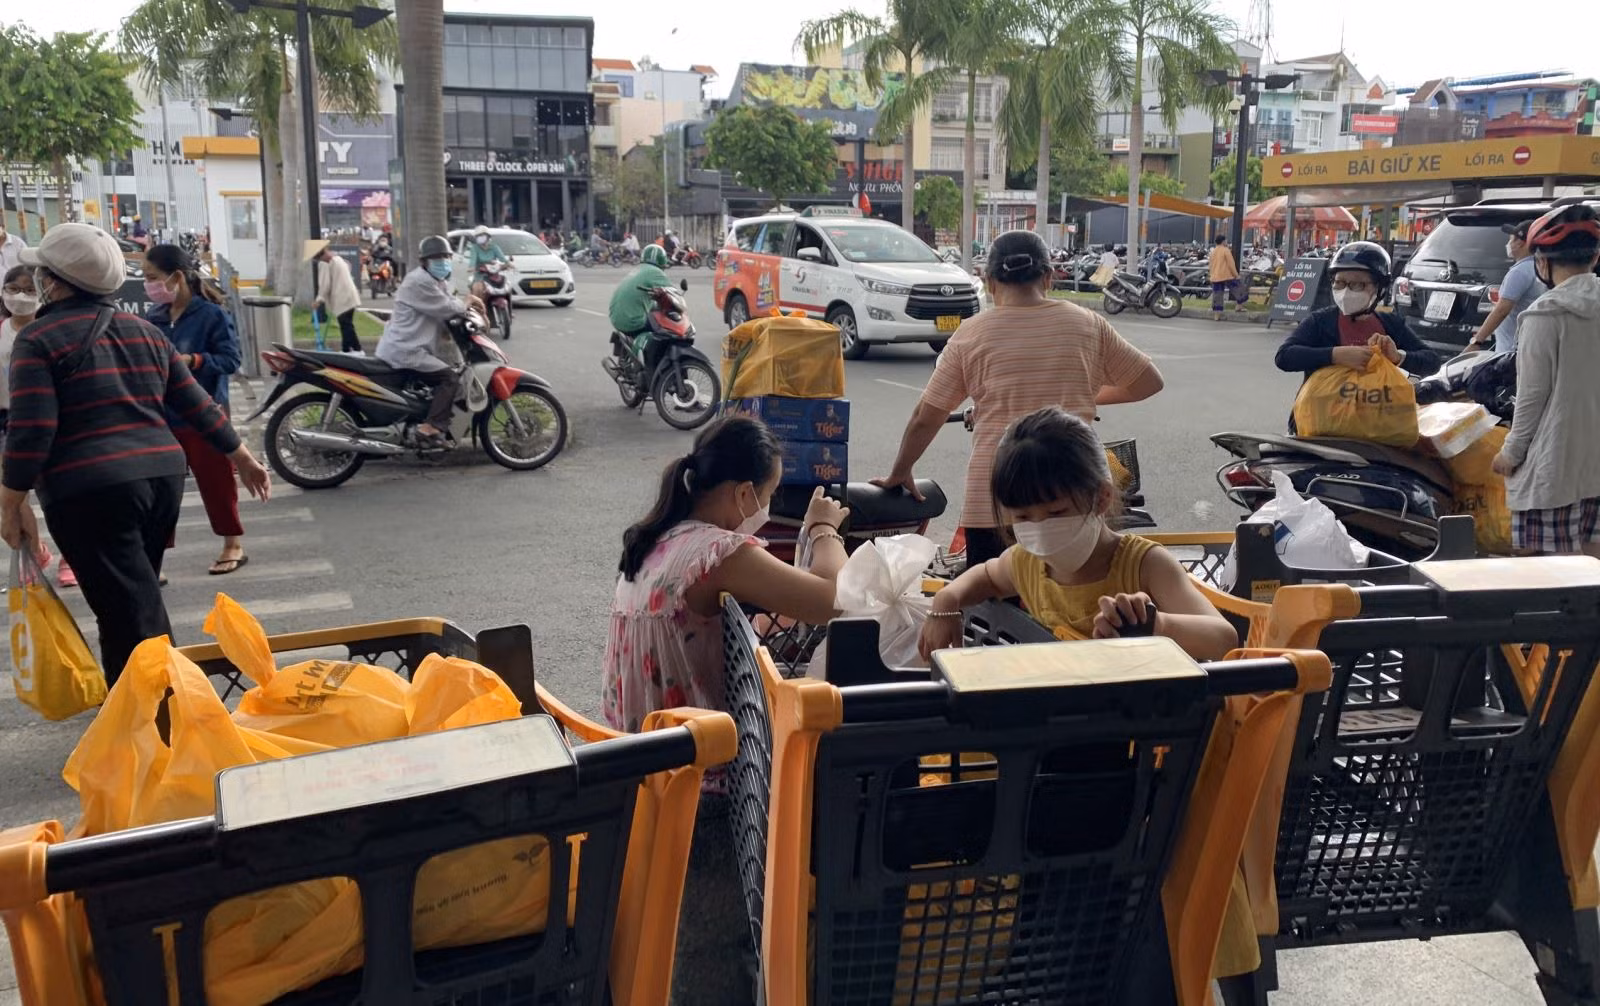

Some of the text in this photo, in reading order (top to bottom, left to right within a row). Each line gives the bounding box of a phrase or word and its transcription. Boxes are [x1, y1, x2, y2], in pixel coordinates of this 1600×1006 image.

[459, 161, 486, 172] THREE
[548, 163, 566, 173] 24H
[1315, 165, 1328, 175] RA
[1416, 155, 1442, 172] XE
[1488, 154, 1505, 165] RA
[815, 421, 844, 438] Tiger
[813, 464, 842, 480] Tiger
